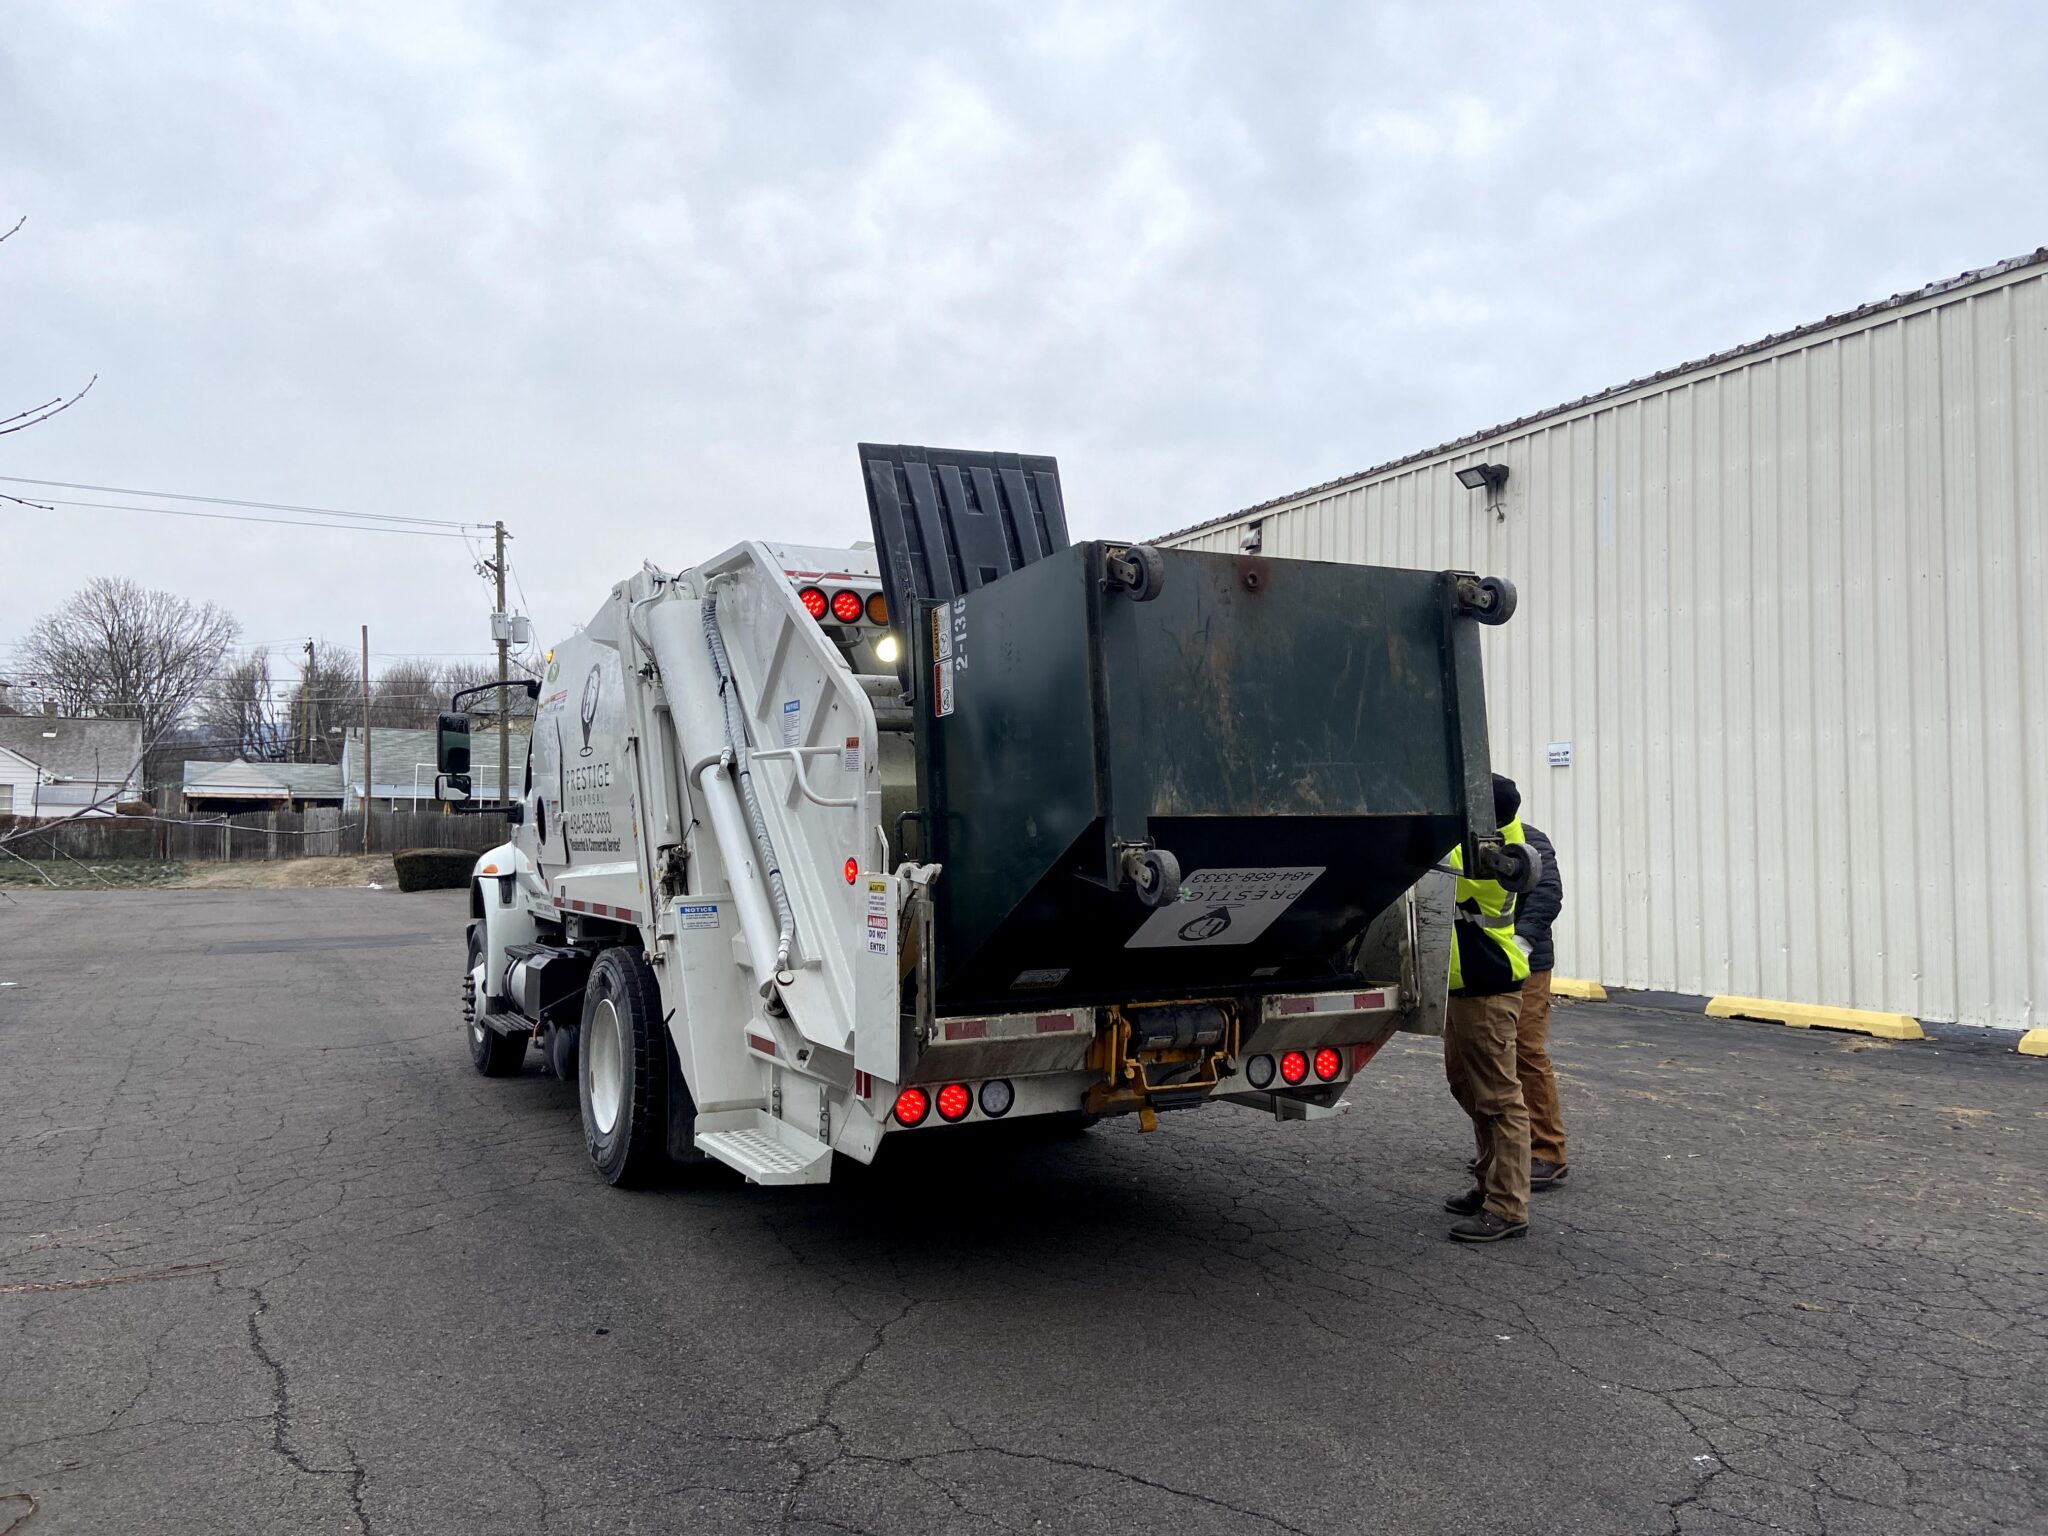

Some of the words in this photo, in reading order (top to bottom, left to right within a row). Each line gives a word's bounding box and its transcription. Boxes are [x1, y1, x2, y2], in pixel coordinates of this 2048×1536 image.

[953, 597, 968, 671] 2-136
[566, 763, 610, 792] PRESTIGE
[571, 793, 605, 807] DISPOSAL
[570, 811, 612, 834] 484-658-3333
[1192, 871, 1314, 883] 484-658-3333
[869, 930, 876, 938] DO
[877, 931, 886, 940] NOT
[870, 942, 886, 952] ENTER
